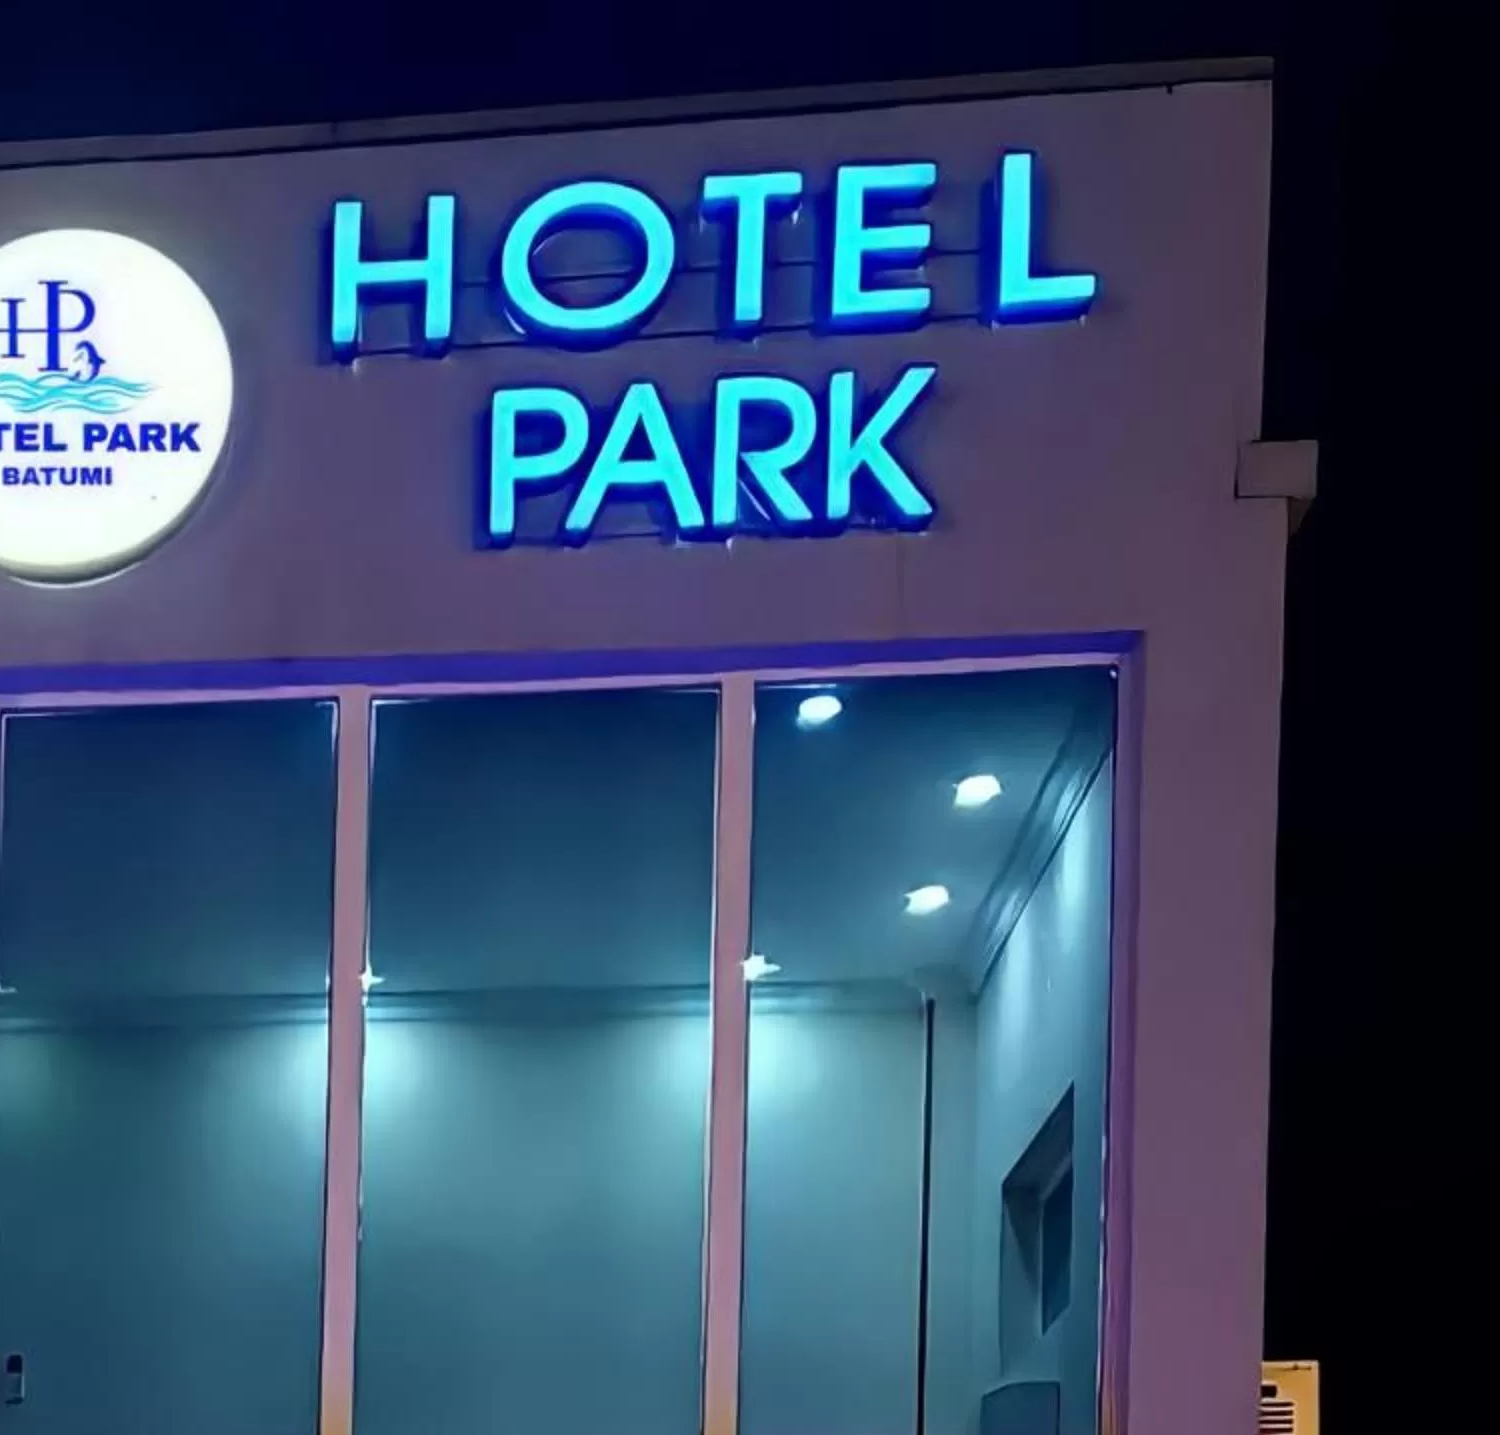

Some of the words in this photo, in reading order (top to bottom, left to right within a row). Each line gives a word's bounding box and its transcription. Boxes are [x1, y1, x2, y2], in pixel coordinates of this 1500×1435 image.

[330, 152, 1097, 345] HOTEL
[1, 465, 114, 487] BATUMI
[82, 421, 202, 454] PARK
[488, 366, 937, 535] PARK
